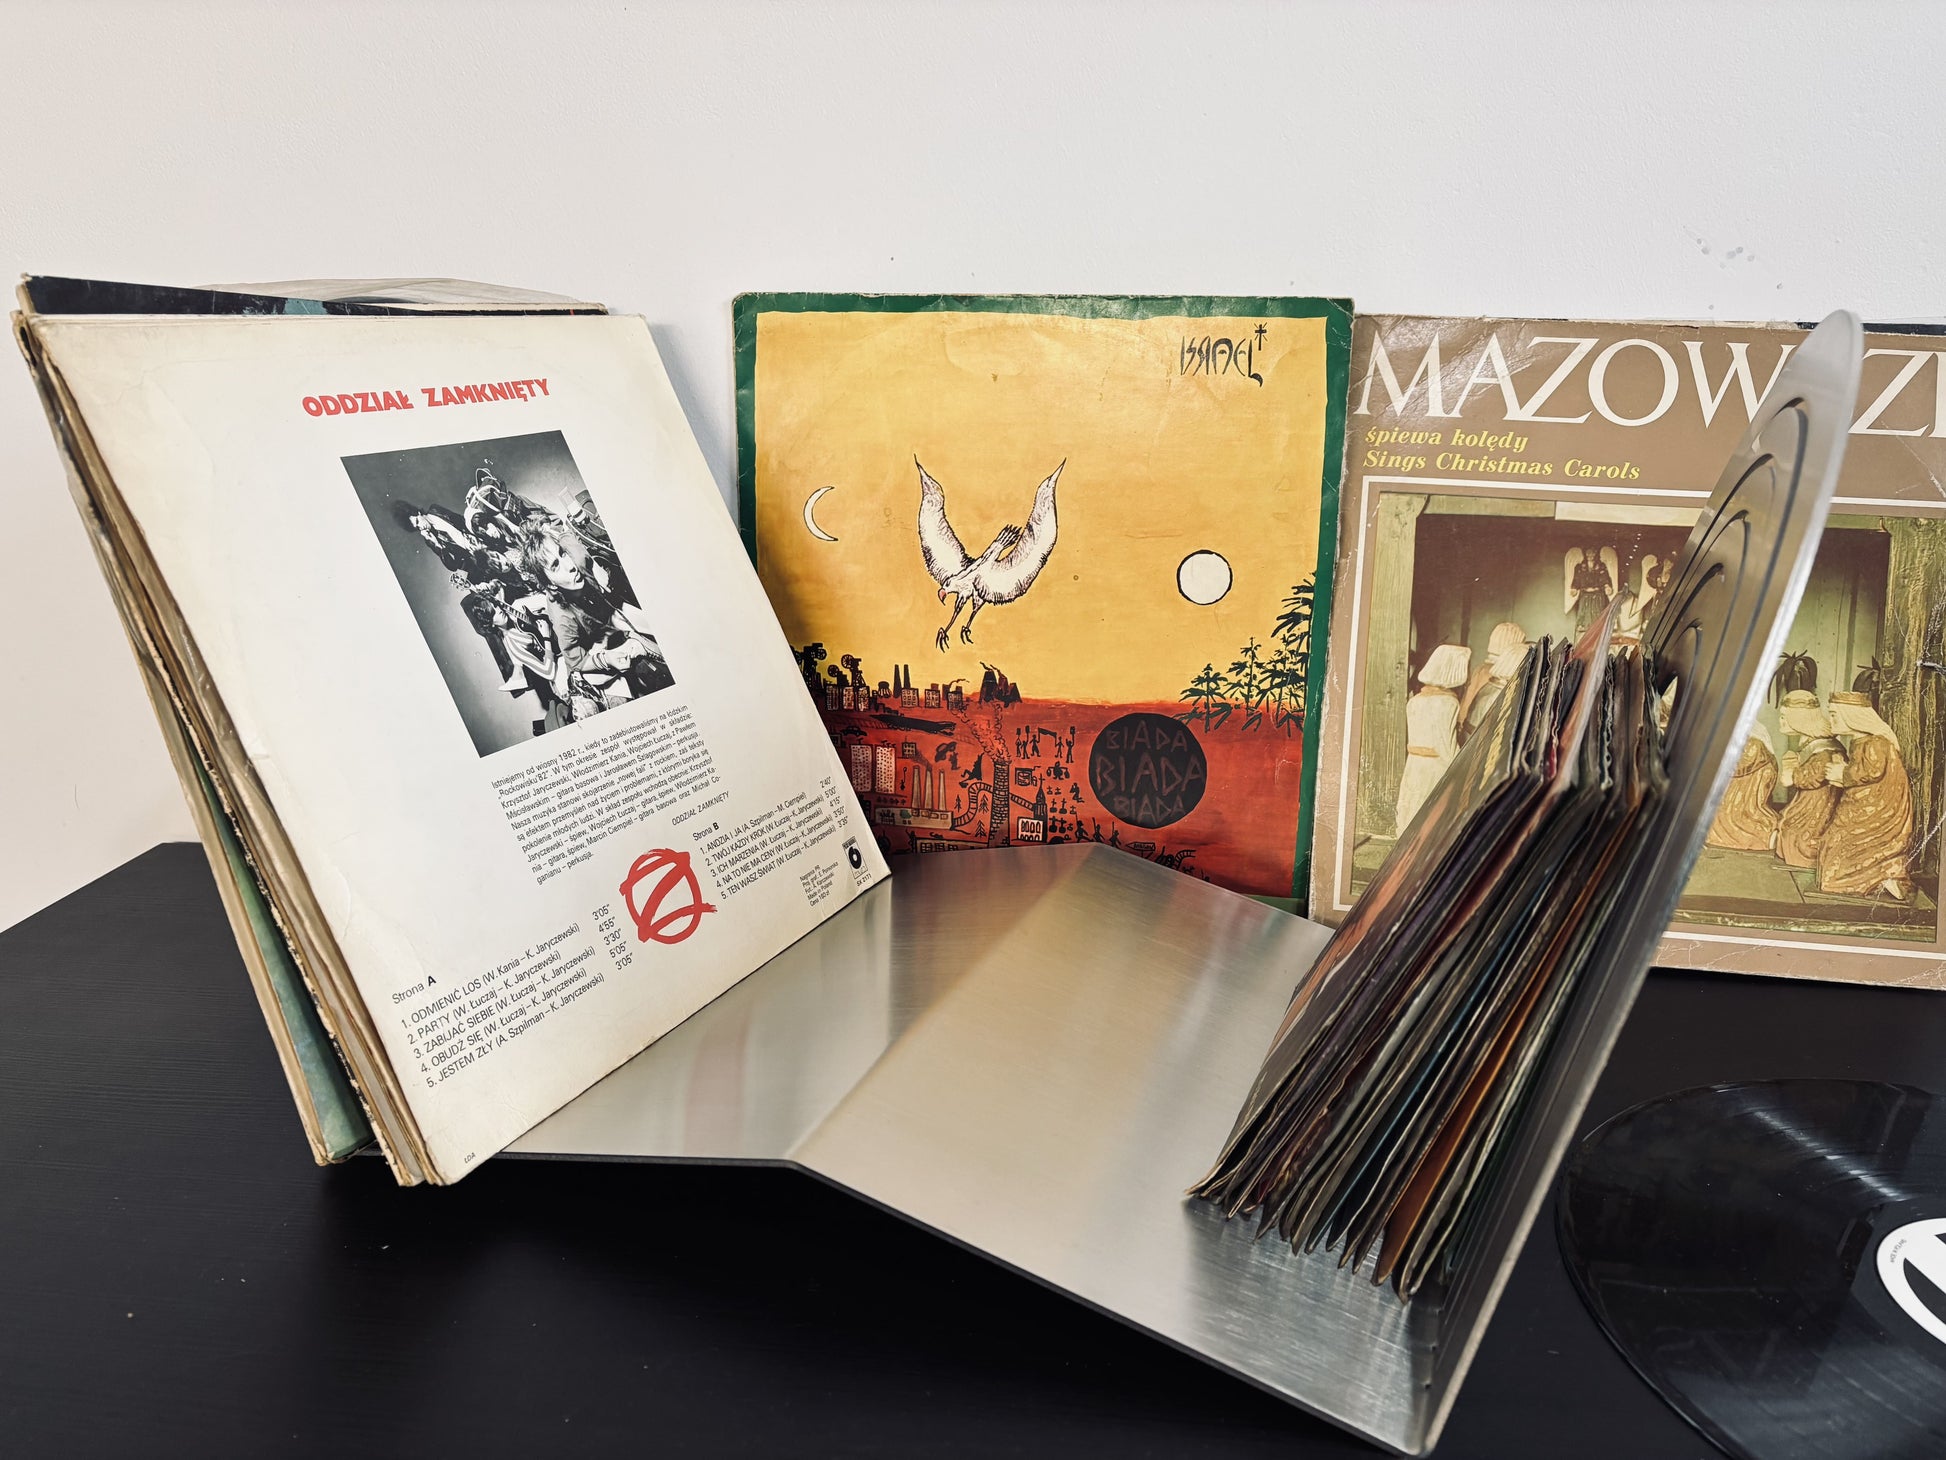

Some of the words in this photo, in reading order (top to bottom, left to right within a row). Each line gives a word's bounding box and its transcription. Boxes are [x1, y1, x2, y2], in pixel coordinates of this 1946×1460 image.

[302, 390, 414, 416] ODDZIAŁ
[421, 378, 550, 407] ZAMKNIĘTY
[1365, 426, 1442, 447] śpiewa
[1450, 428, 1529, 453] kolędy
[1363, 450, 1427, 472] Sings
[1436, 452, 1553, 475] Christmas
[1564, 458, 1640, 480] Carols
[1106, 720, 1187, 752] BIADA
[1096, 753, 1203, 796] BIADA
[1113, 793, 1186, 825] BIADA
[693, 827, 713, 841] Strona
[712, 822, 720, 831] B
[392, 983, 425, 1004] Strona
[428, 976, 437, 987] A
[402, 1020, 412, 1029] 1.
[411, 988, 462, 1023] ODMIENIĆ
[462, 978, 482, 996] LOS
[482, 970, 498, 986] (W.
[497, 959, 521, 976] Kania
[536, 923, 580, 955] Jaryczewski)
[408, 1034, 418, 1045] 2.
[417, 1013, 450, 1039] PARTY
[453, 1004, 470, 1020] (W.
[469, 987, 498, 1010] Łuczaj
[514, 950, 562, 984] Jaryczewski)
[414, 1048, 424, 1059] 3.
[424, 1021, 466, 1053] ZABIJAĆ
[467, 1005, 496, 1028] SIEBIE
[495, 997, 511, 1013] (W.
[510, 981, 537, 1003] Łuczaj
[552, 946, 596, 979] Jaryczewski)
[422, 1063, 431, 1072] 4.
[431, 1039, 466, 1067] OBUDŹ
[467, 1030, 484, 1046] SIĘ
[484, 1021, 500, 1038] (W.
[499, 1004, 527, 1027] Łuczaj
[542, 968, 587, 1002] Jaryczewski)
[426, 1077, 438, 1088] 5.
[439, 1052, 475, 1082] JESTEM
[475, 1040, 493, 1058] ZŁY
[496, 1034, 508, 1047] (A.
[508, 1012, 545, 1038] Szpilman
[560, 973, 605, 1007] Jaryczewski)
